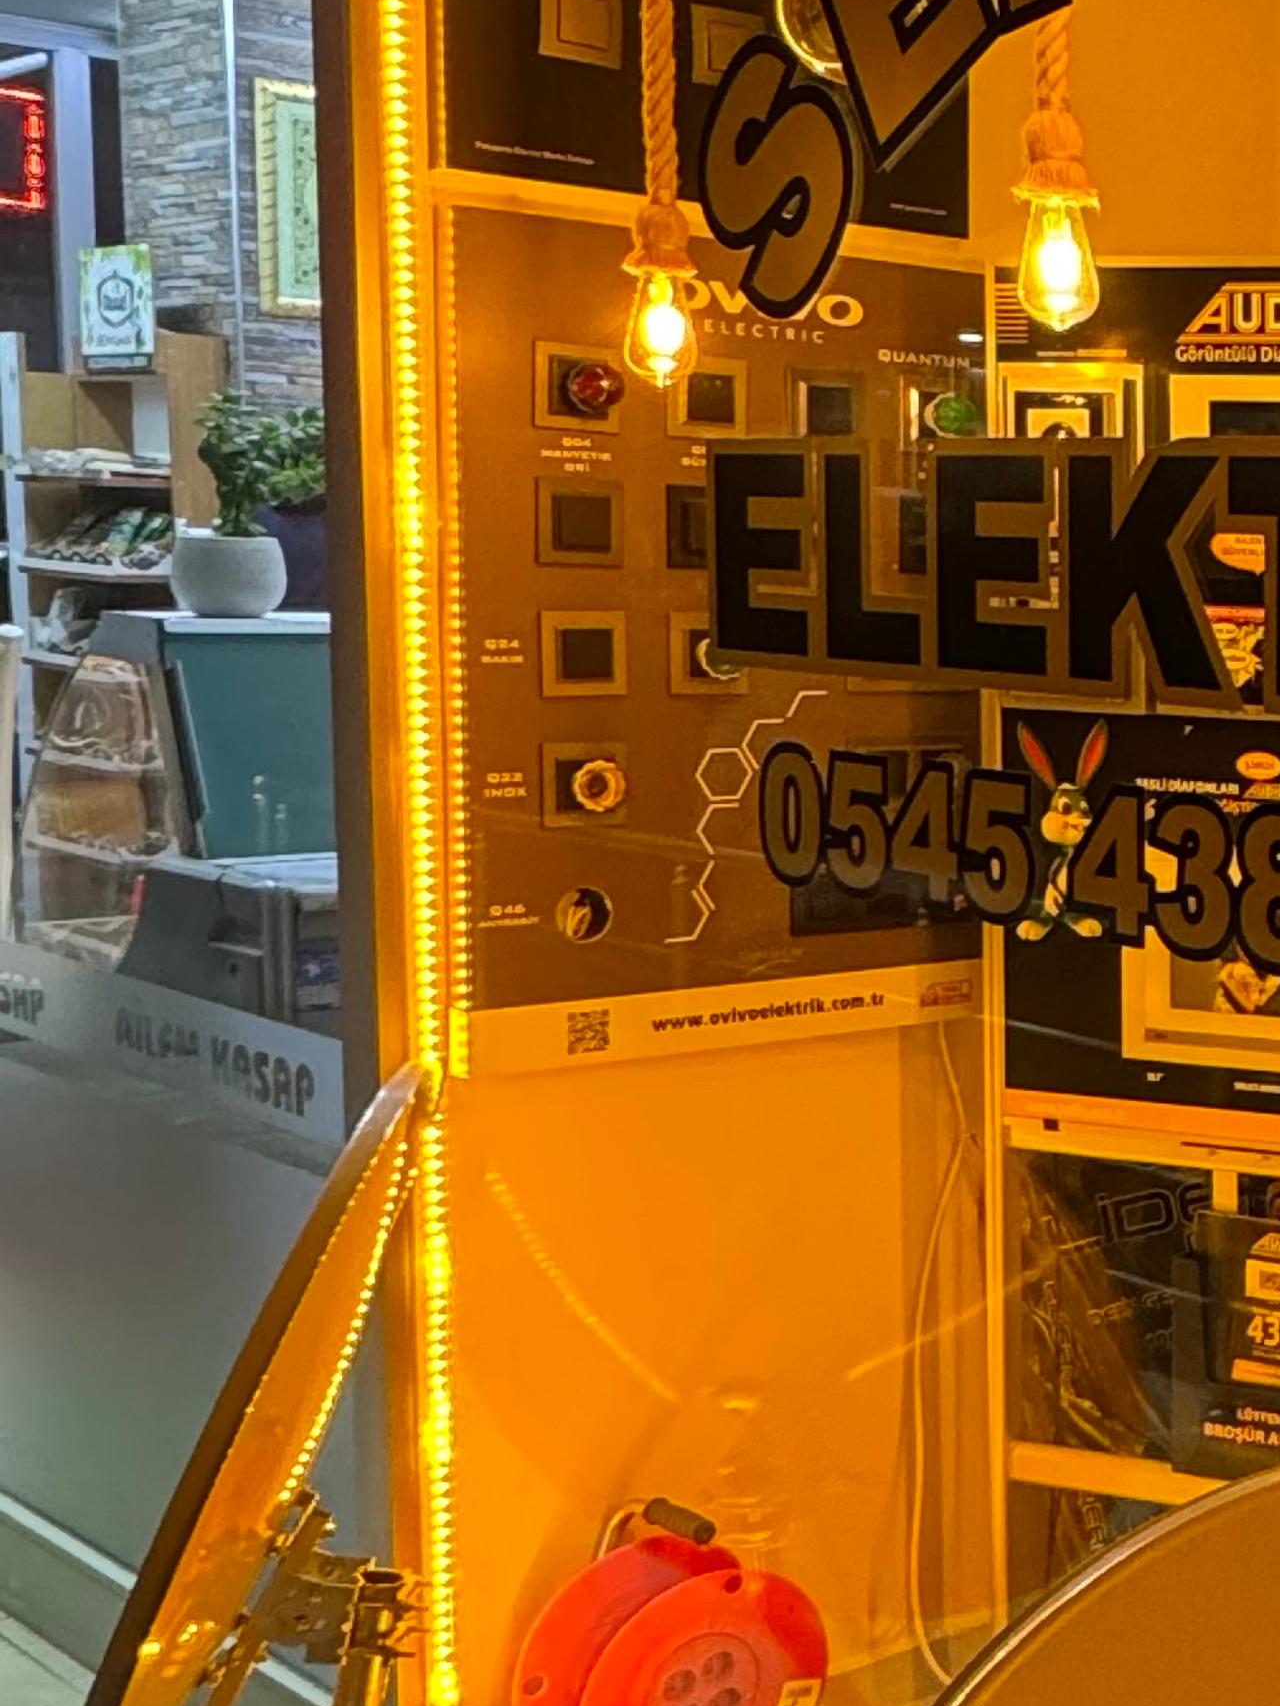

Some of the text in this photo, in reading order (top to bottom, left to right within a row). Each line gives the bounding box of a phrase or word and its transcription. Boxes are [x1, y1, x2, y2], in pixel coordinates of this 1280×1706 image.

[703, 318, 826, 345] ELECTRIC
[877, 348, 971, 369] QUANTUM
[1175, 344, 1258, 364] Görüntülü
[759, 740, 1038, 925] 0545
[209, 1035, 316, 1118] KASAP
[1204, 1421, 1266, 1446] BROŞÜR
